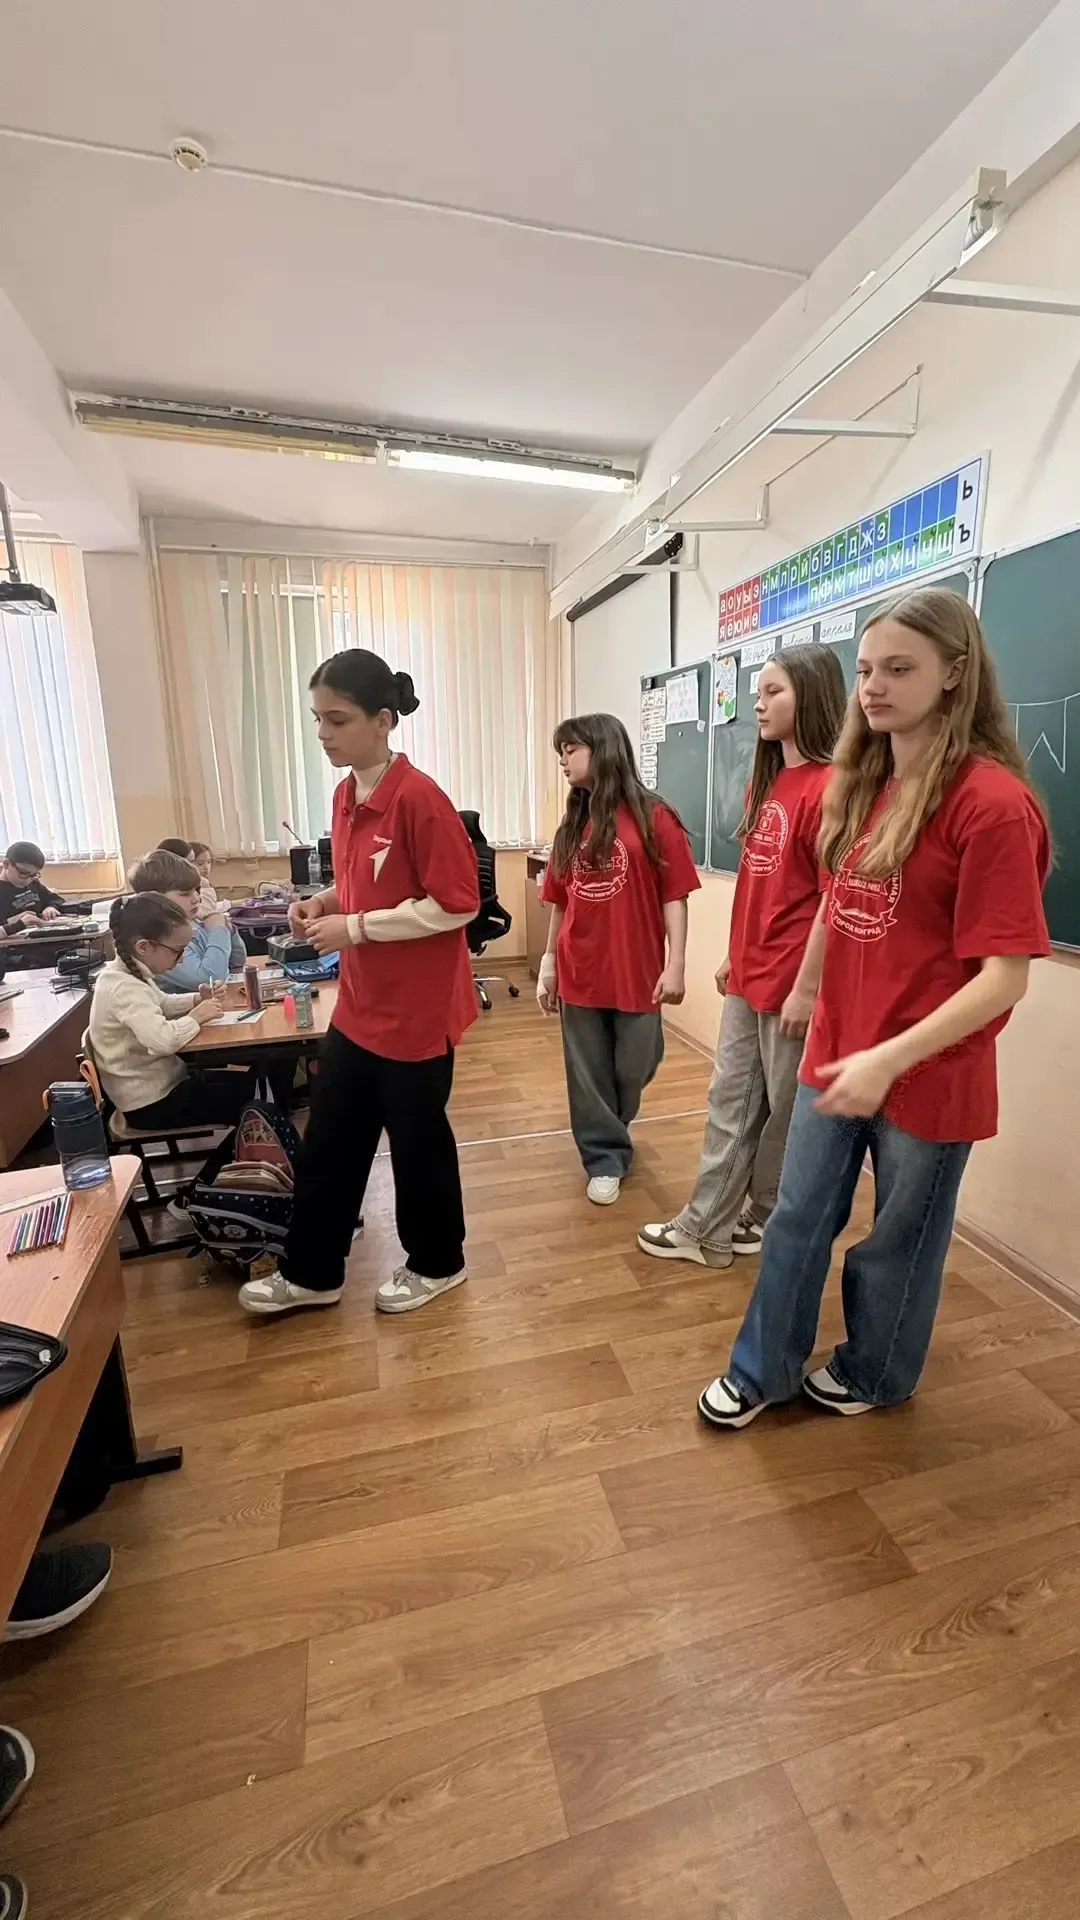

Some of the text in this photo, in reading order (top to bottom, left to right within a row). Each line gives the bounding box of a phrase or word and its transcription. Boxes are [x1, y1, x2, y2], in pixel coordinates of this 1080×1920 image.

[720, 600, 726, 613] а
[728, 596, 734, 609] о
[736, 592, 742, 610] у
[743, 588, 751, 604] ы
[753, 584, 759, 599] э
[762, 580, 768, 595] н
[770, 574, 778, 591] м
[780, 571, 787, 587] л
[791, 565, 797, 586] р
[811, 549, 821, 573] б
[824, 549, 831, 567] в
[837, 543, 843, 560] г
[848, 536, 858, 559] д
[861, 527, 874, 550] ж
[877, 522, 886, 541] з
[962, 480, 973, 500] ь
[720, 625, 725, 639] я
[734, 619, 742, 634] ю
[752, 612, 758, 627] е
[889, 551, 901, 573] х
[958, 523, 971, 544] ъ
